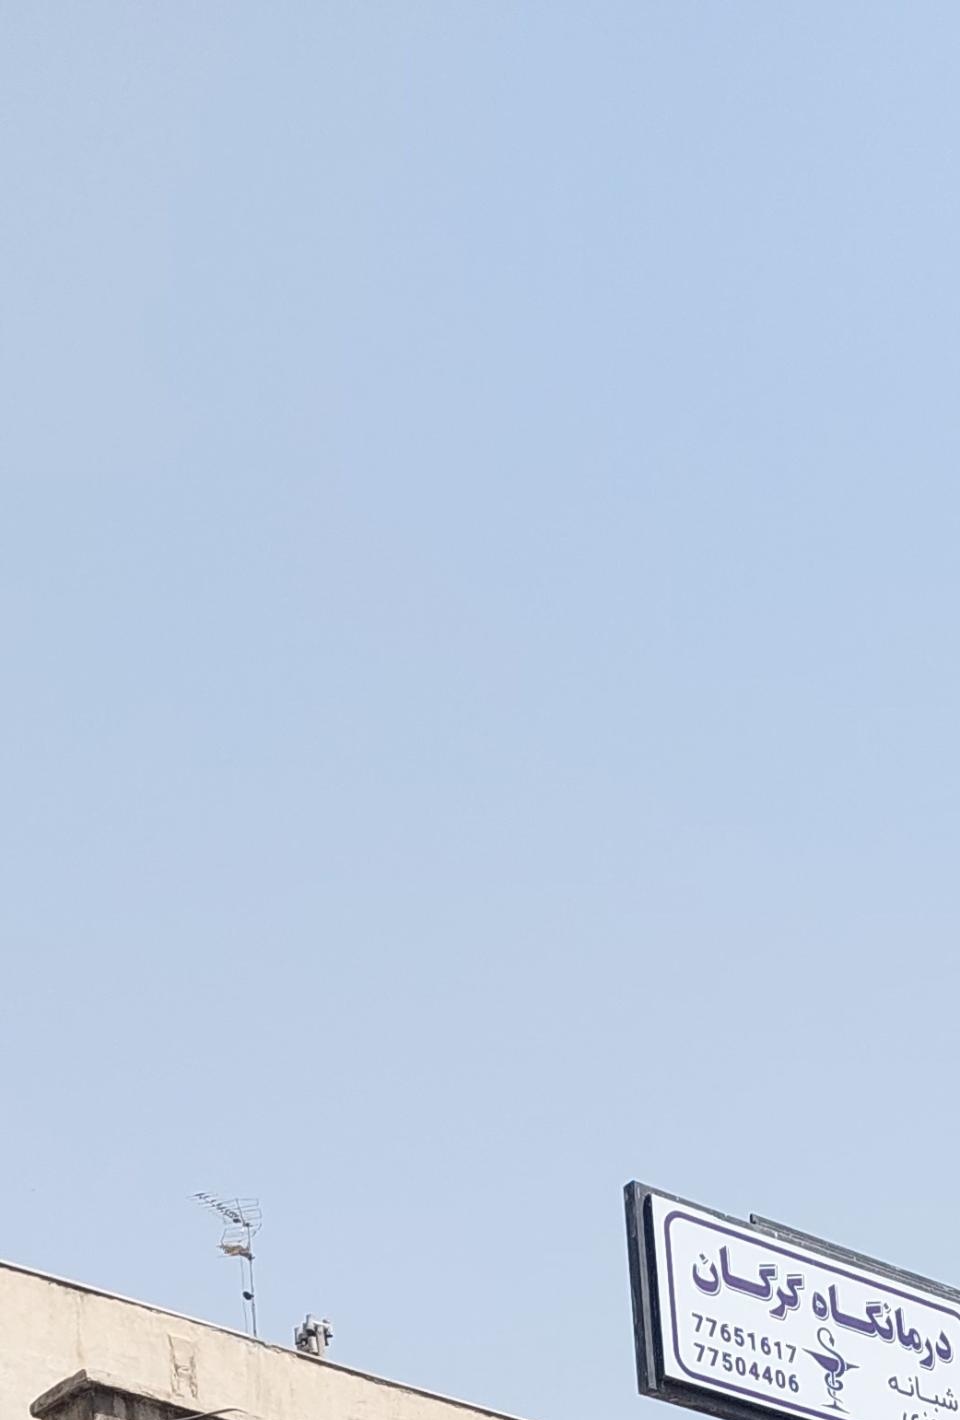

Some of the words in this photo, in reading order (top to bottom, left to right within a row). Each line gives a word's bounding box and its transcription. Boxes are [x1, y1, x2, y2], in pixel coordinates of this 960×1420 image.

[692, 1244, 803, 1320] گرگان
[691, 1312, 797, 1364] 77651617
[813, 1285, 953, 1371] درمانگاه
[693, 1342, 800, 1393] 77504406
[887, 1374, 959, 1413] شبانه
